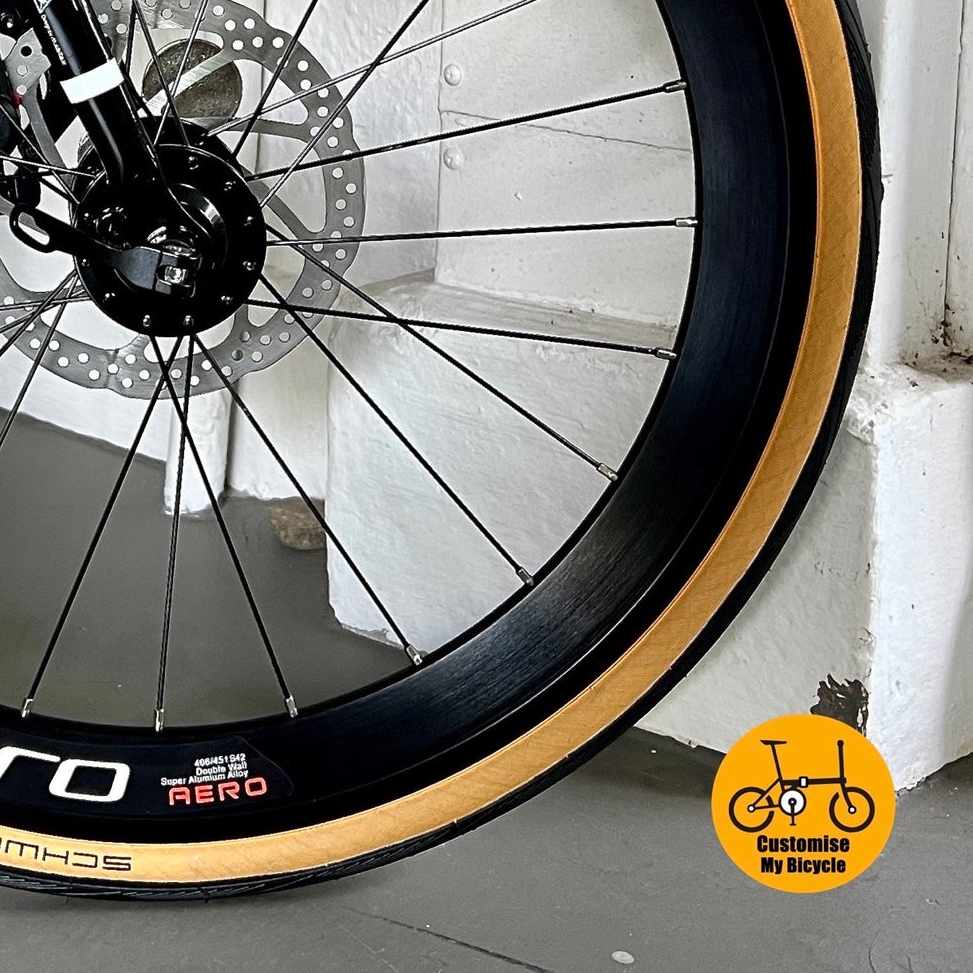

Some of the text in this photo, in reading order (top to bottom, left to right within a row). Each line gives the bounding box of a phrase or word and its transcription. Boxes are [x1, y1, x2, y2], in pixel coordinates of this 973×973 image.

[195, 761, 247, 776] Double Wall
[160, 777, 186, 786] Super
[227, 769, 248, 779] Alloy
[169, 777, 267, 805] AERO
